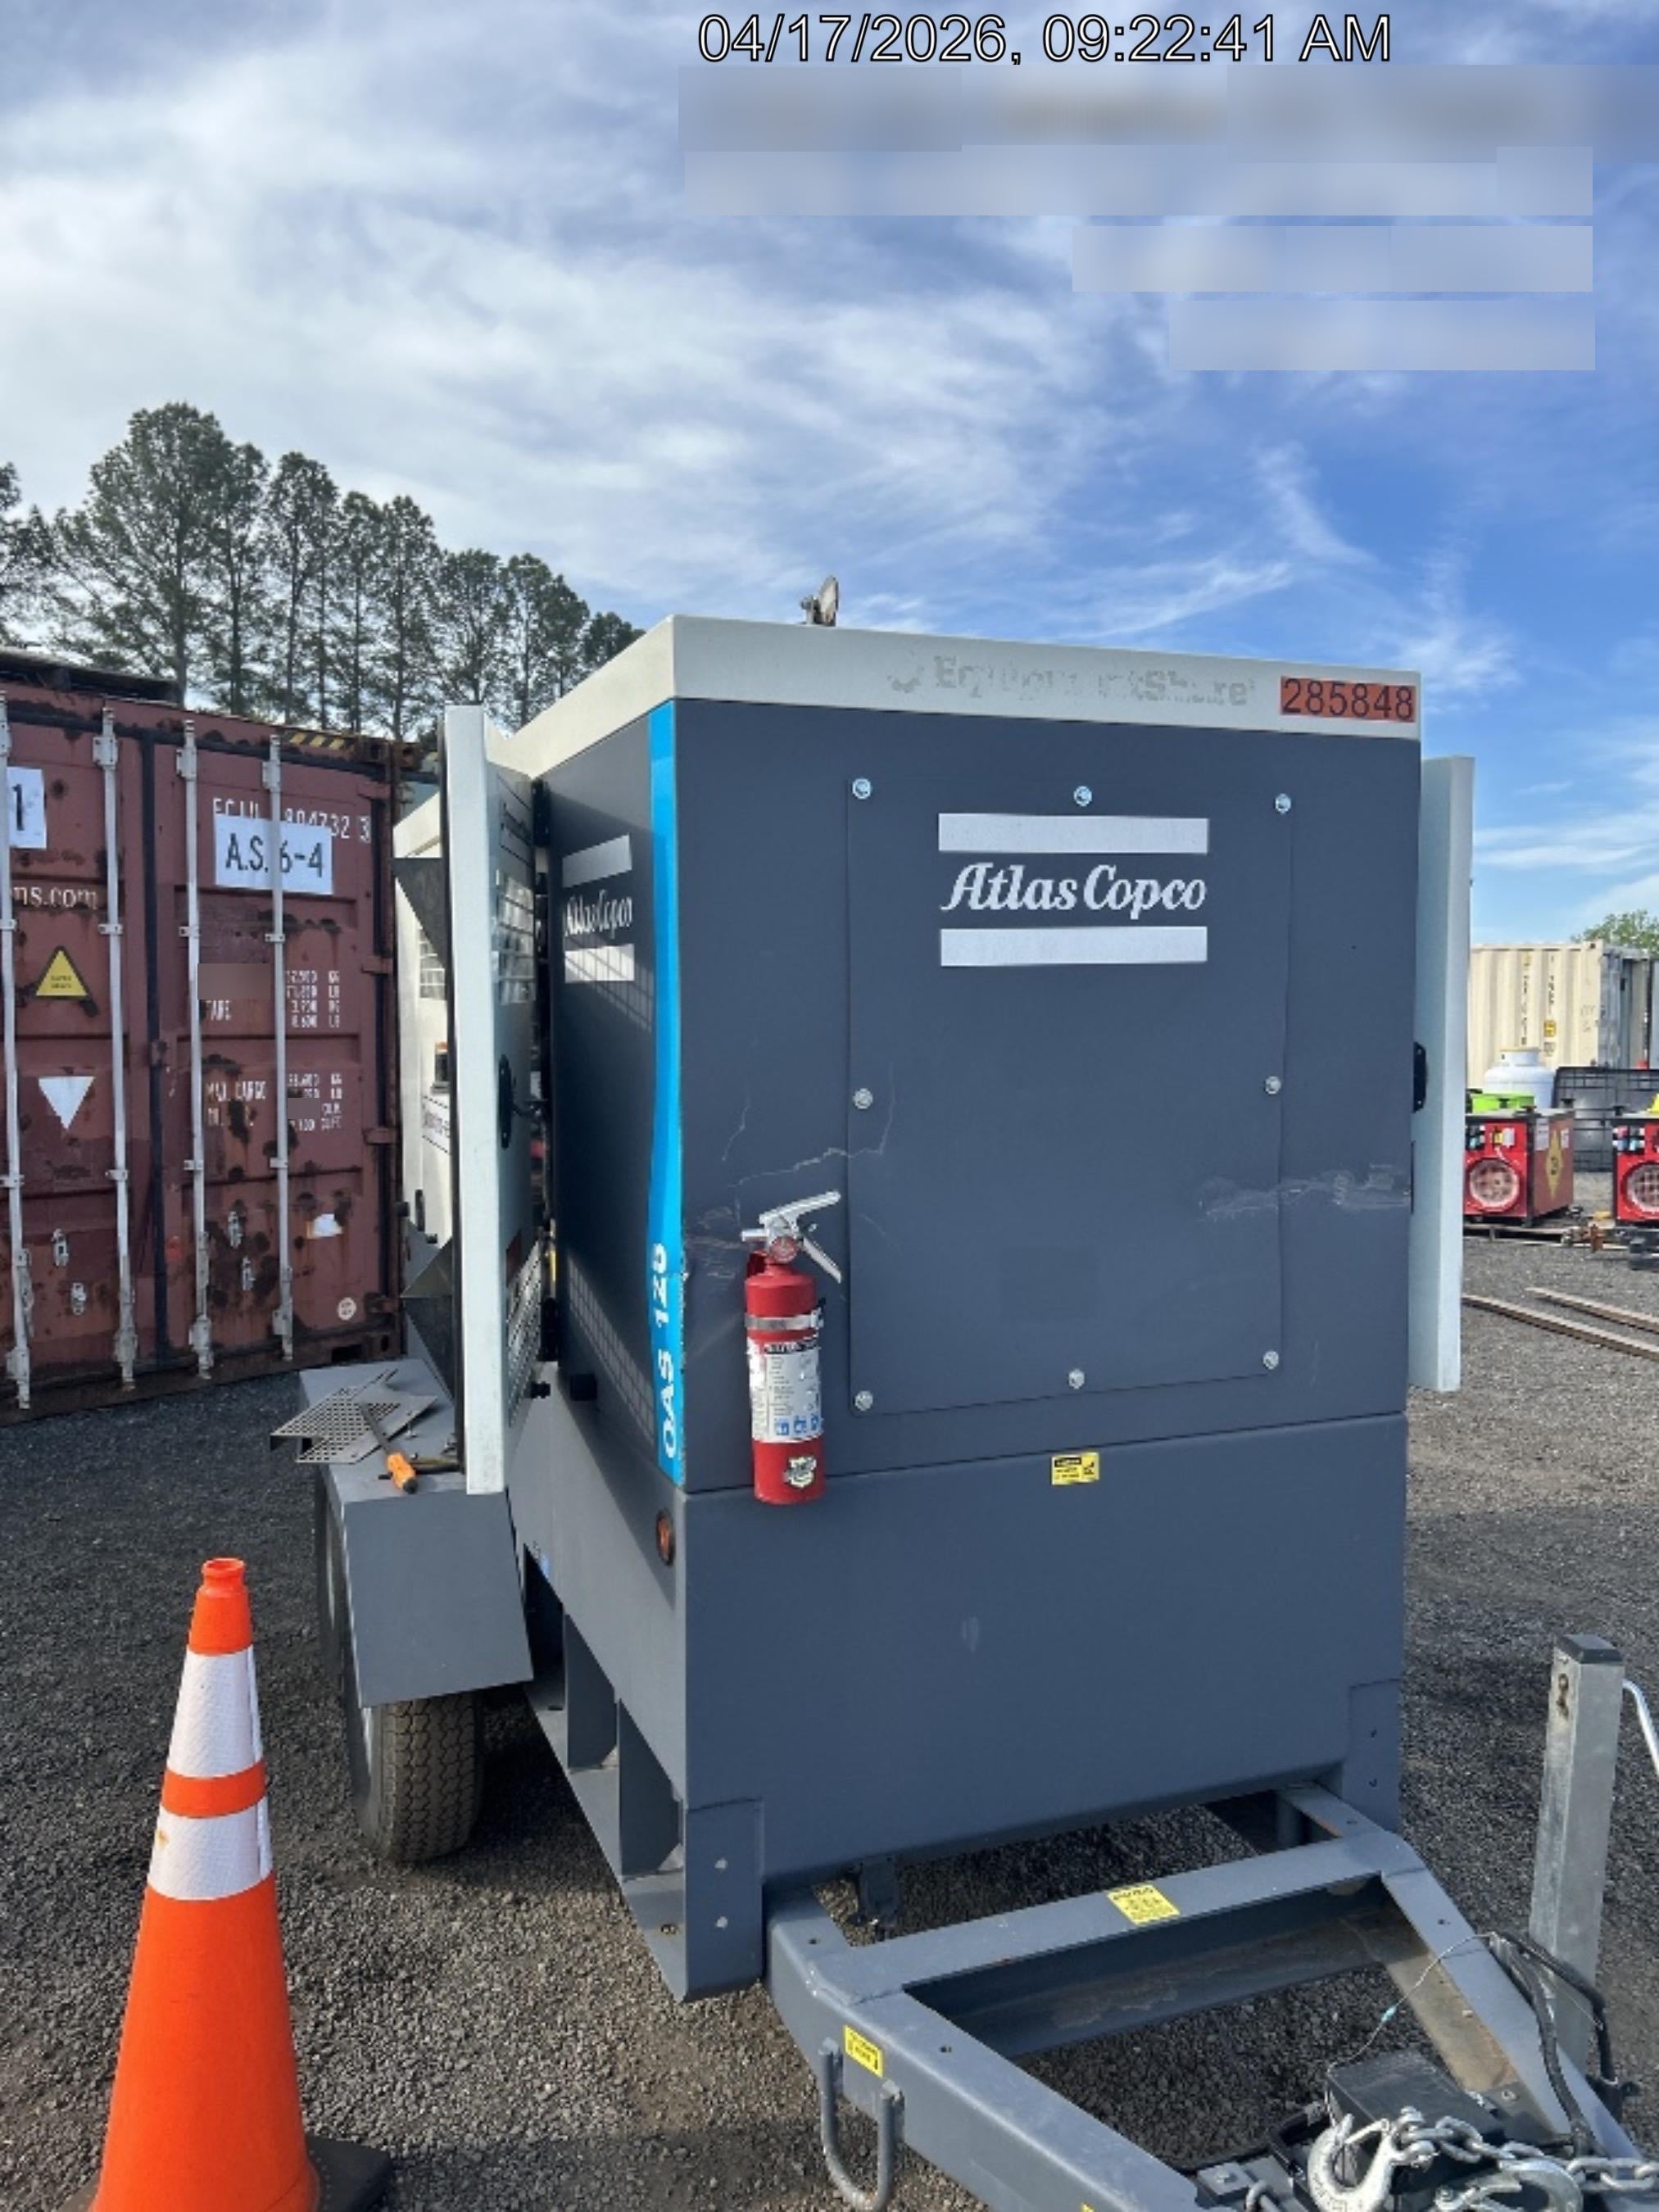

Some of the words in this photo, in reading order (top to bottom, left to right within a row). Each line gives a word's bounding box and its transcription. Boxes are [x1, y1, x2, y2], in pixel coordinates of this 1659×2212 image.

[1283, 678, 1412, 720] 285848
[225, 832, 269, 873] A.S.
[941, 862, 1077, 910] Atlas
[1084, 864, 1207, 919] Copco
